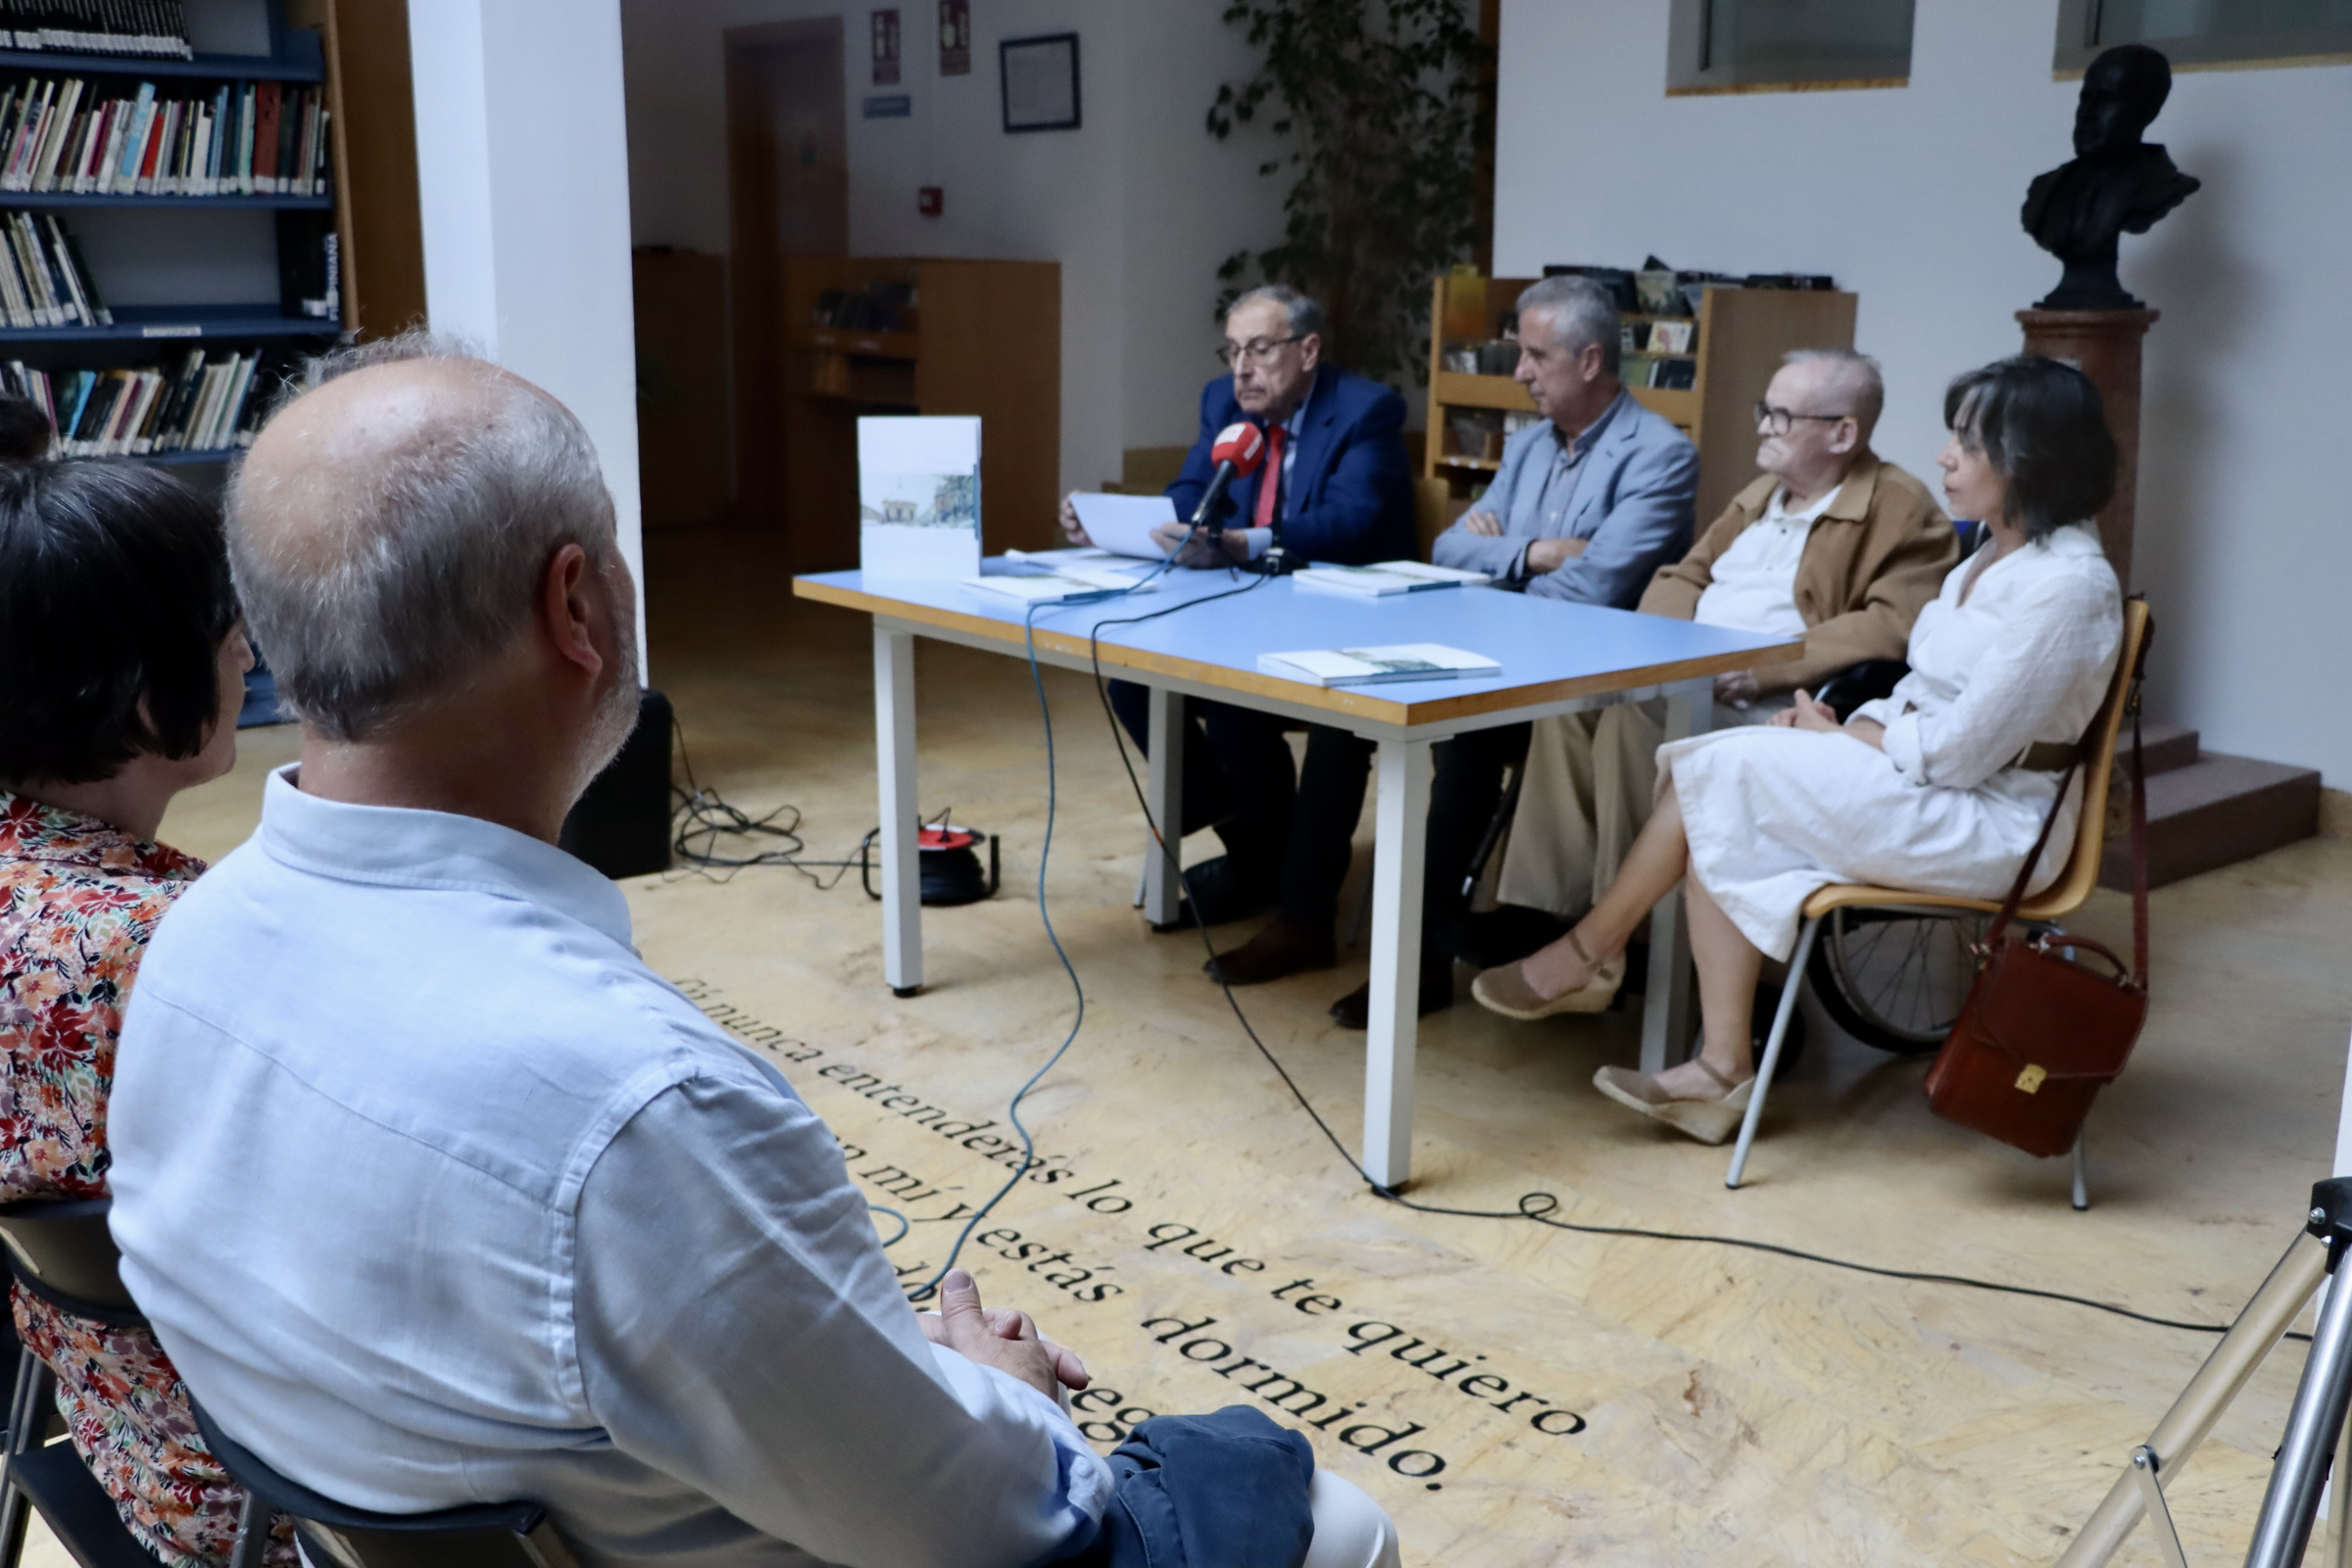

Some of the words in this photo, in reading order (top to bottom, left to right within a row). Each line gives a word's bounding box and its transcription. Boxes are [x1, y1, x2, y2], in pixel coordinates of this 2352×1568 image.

[702, 1004, 824, 1062] nunca
[817, 1064, 1075, 1185] entenderás
[1064, 1178, 1133, 1214] lo
[1143, 1222, 1266, 1276] que
[1270, 1277, 1343, 1316] te
[1342, 1320, 1588, 1437] quiero
[858, 1164, 965, 1202] mí
[976, 1228, 1125, 1302] estás
[1140, 1316, 1447, 1492] dormido.
